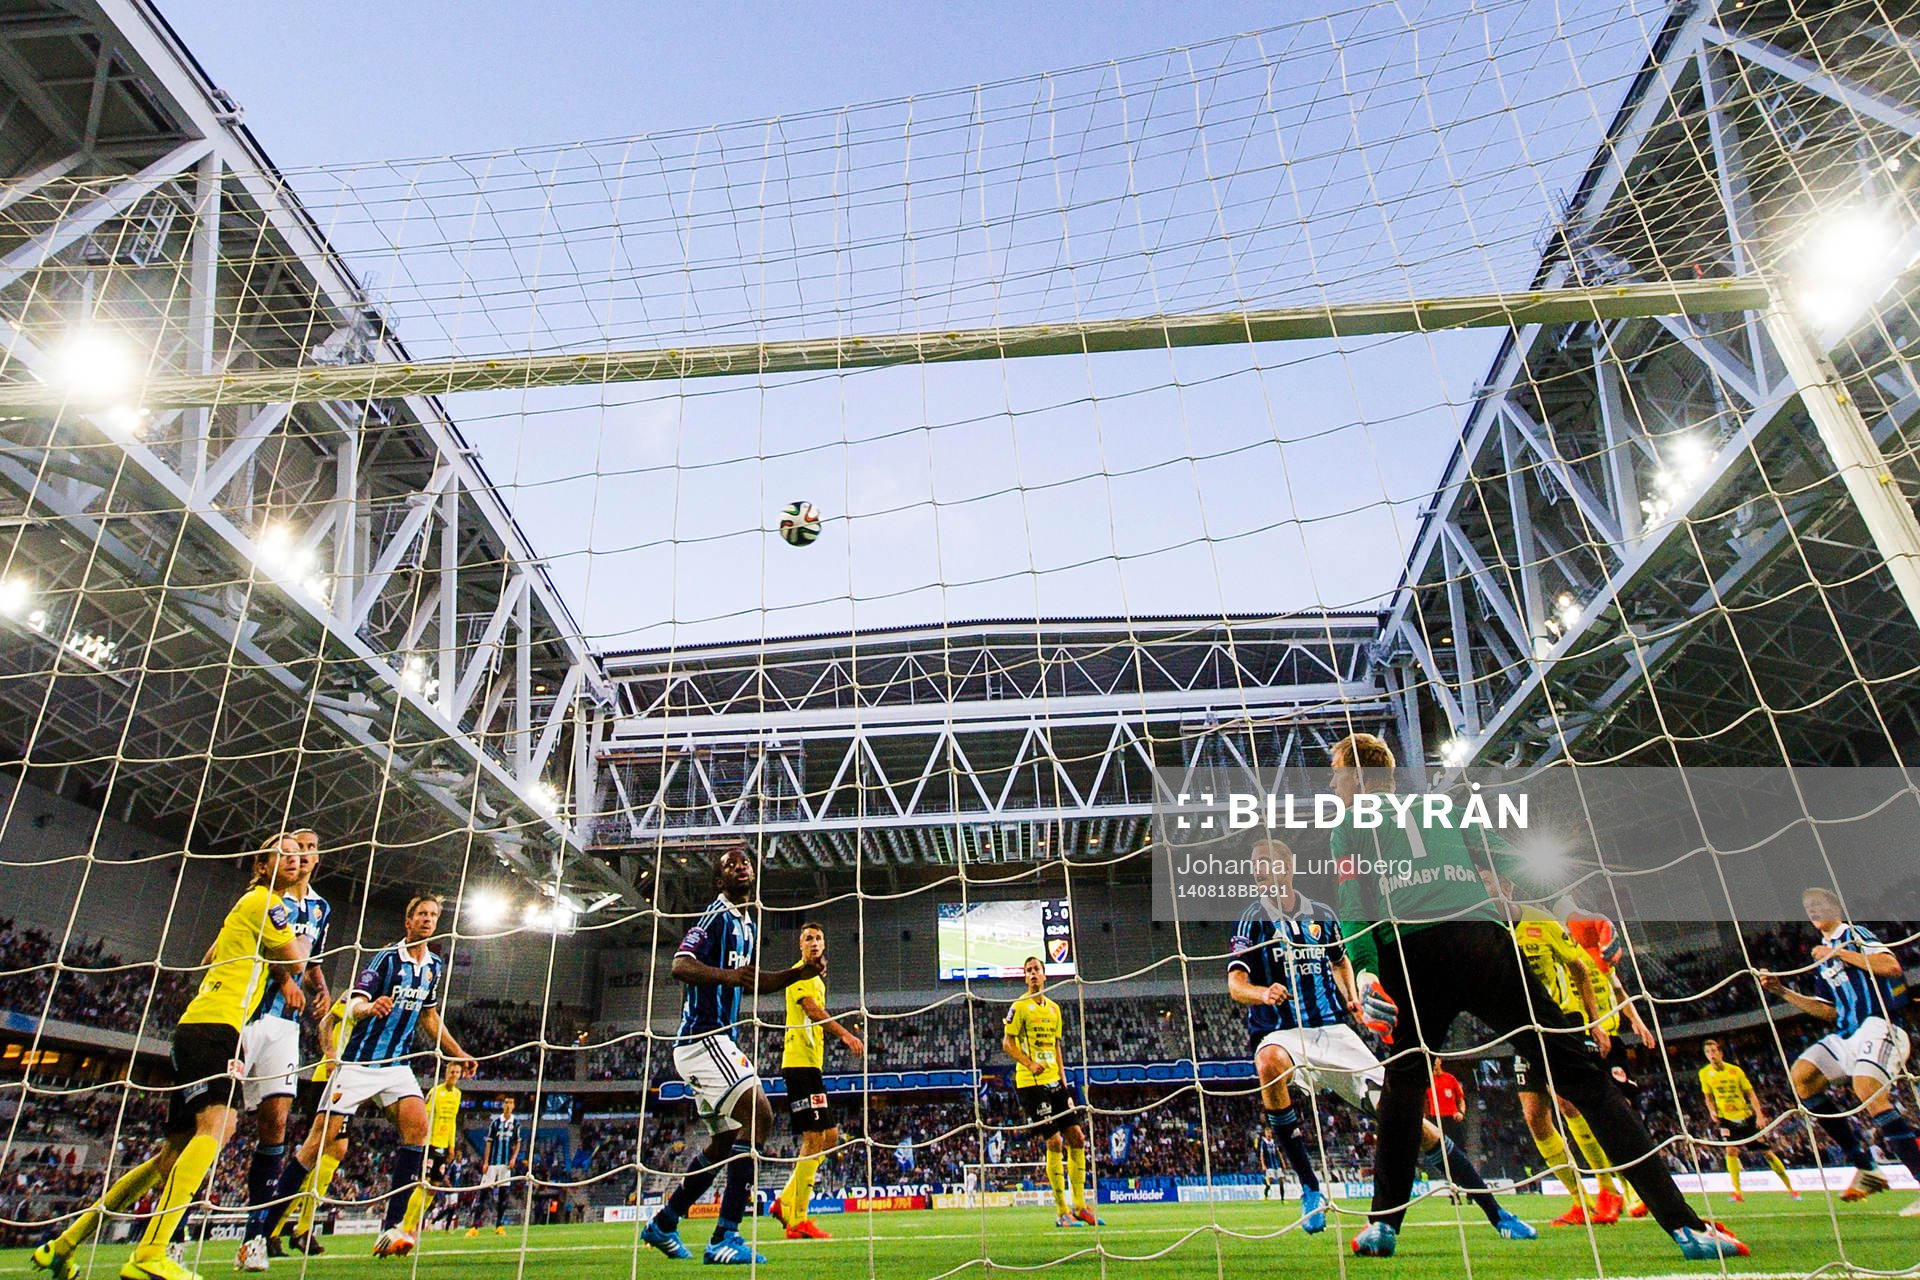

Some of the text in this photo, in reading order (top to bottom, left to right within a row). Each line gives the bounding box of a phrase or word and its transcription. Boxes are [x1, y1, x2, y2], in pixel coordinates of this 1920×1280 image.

[1045, 908, 1052, 920] 3
[1061, 907, 1069, 920] 0
[1272, 947, 1326, 962] Proritet
[1284, 962, 1322, 977] Fnans
[1863, 1040, 1873, 1055] 3
